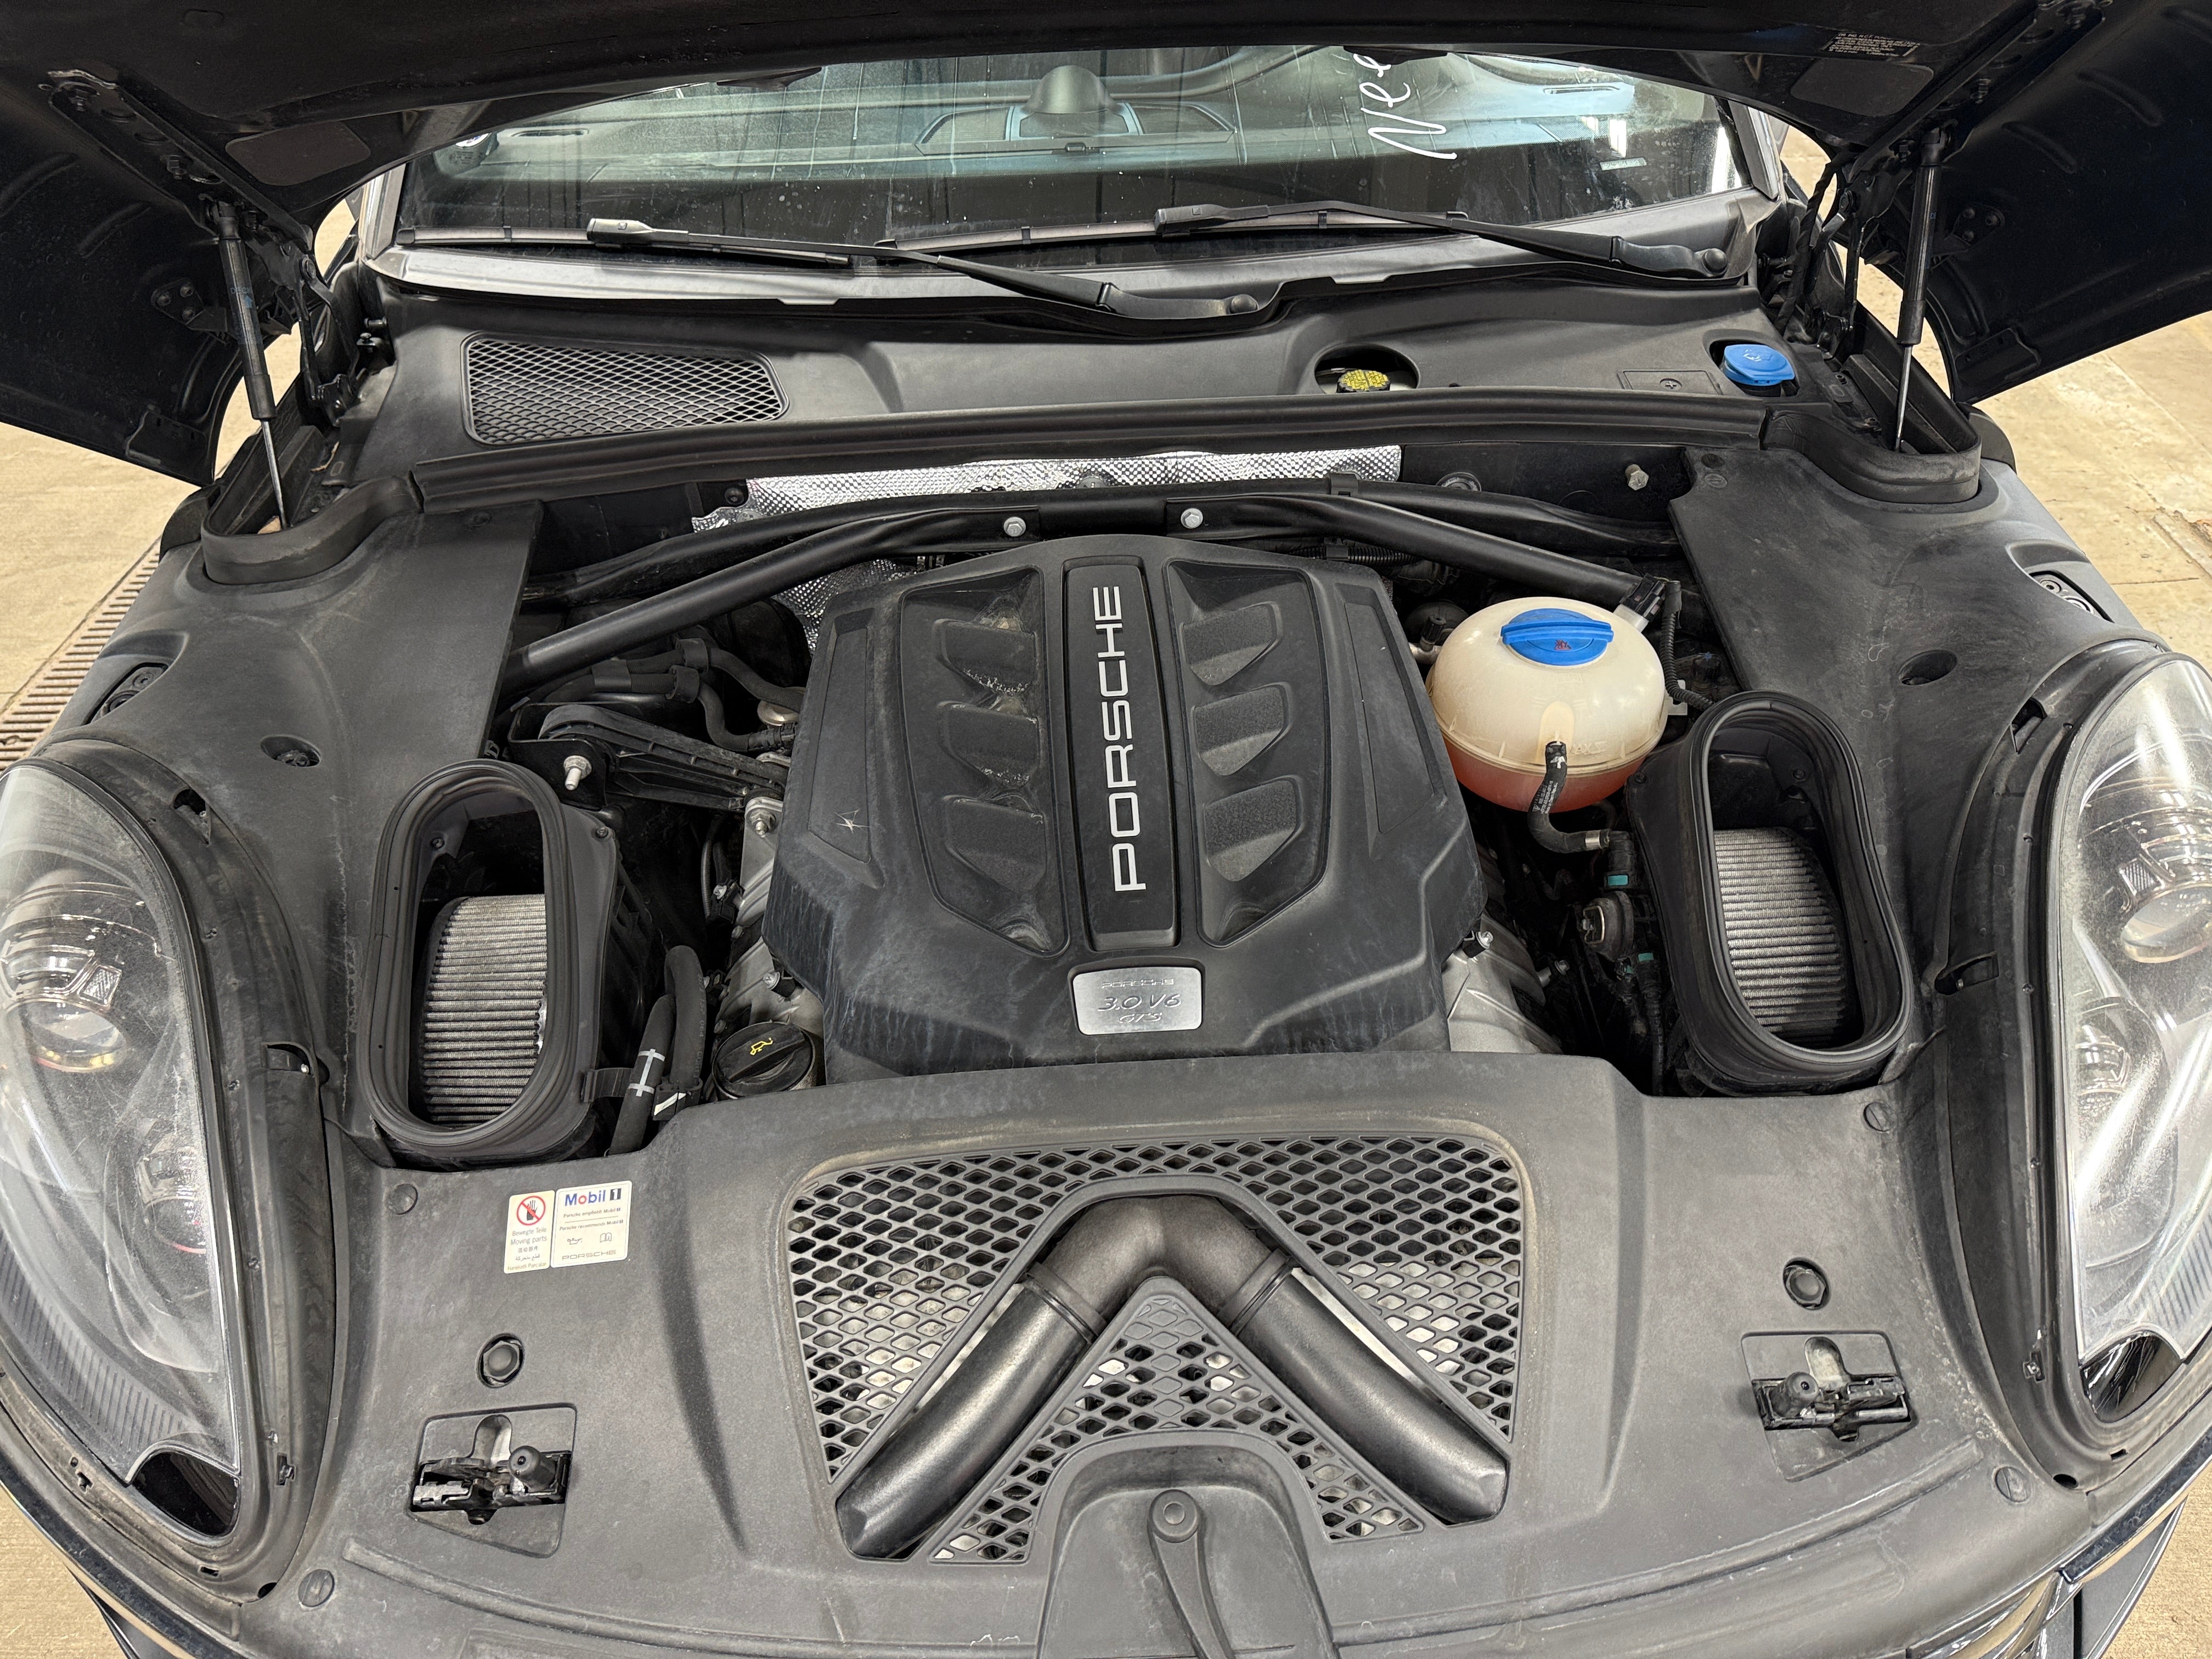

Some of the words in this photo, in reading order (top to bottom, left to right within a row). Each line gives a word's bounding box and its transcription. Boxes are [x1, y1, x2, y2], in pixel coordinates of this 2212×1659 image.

[1093, 585, 1146, 893] PORSCHE
[1101, 978, 1174, 989] PORSCHE
[1098, 995, 1142, 1012] 3.0
[1149, 994, 1182, 1009] V6
[1119, 1012, 1163, 1023] GTS
[565, 1189, 606, 1207] Mobil
[562, 1250, 617, 1261] PORSCHE
